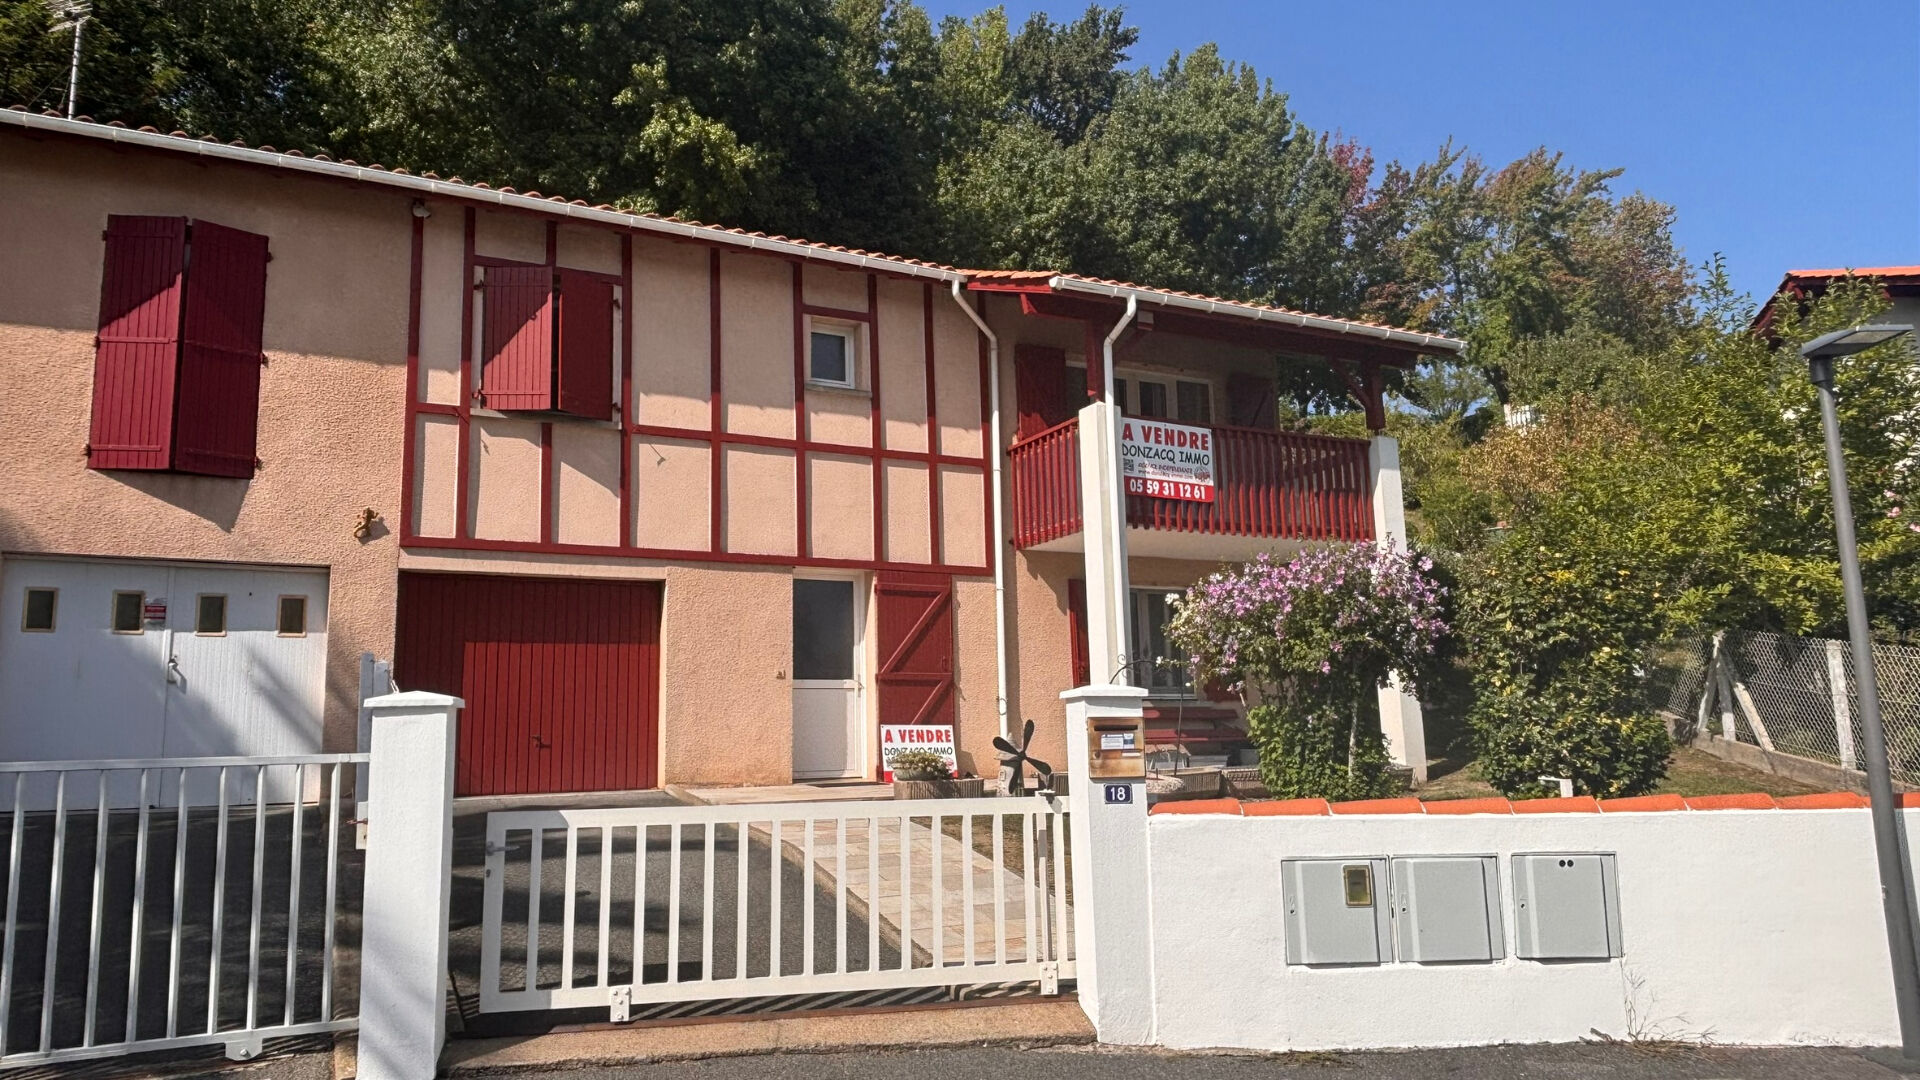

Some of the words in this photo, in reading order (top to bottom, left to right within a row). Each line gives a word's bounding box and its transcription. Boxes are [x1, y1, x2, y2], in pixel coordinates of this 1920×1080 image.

[1122, 423, 1134, 441] A
[1141, 425, 1209, 451] VENDRE
[1122, 443, 1175, 464] DONZACQ
[1179, 451, 1210, 466] IMMO
[1130, 479, 1143, 492] 05
[1147, 480, 1160, 494] 59
[1162, 482, 1175, 496] 31
[1179, 484, 1191, 498] 12
[1194, 485, 1205, 499] 61
[884, 729, 893, 743] A
[898, 729, 952, 743] VENDRE
[1110, 787, 1126, 801] 18
